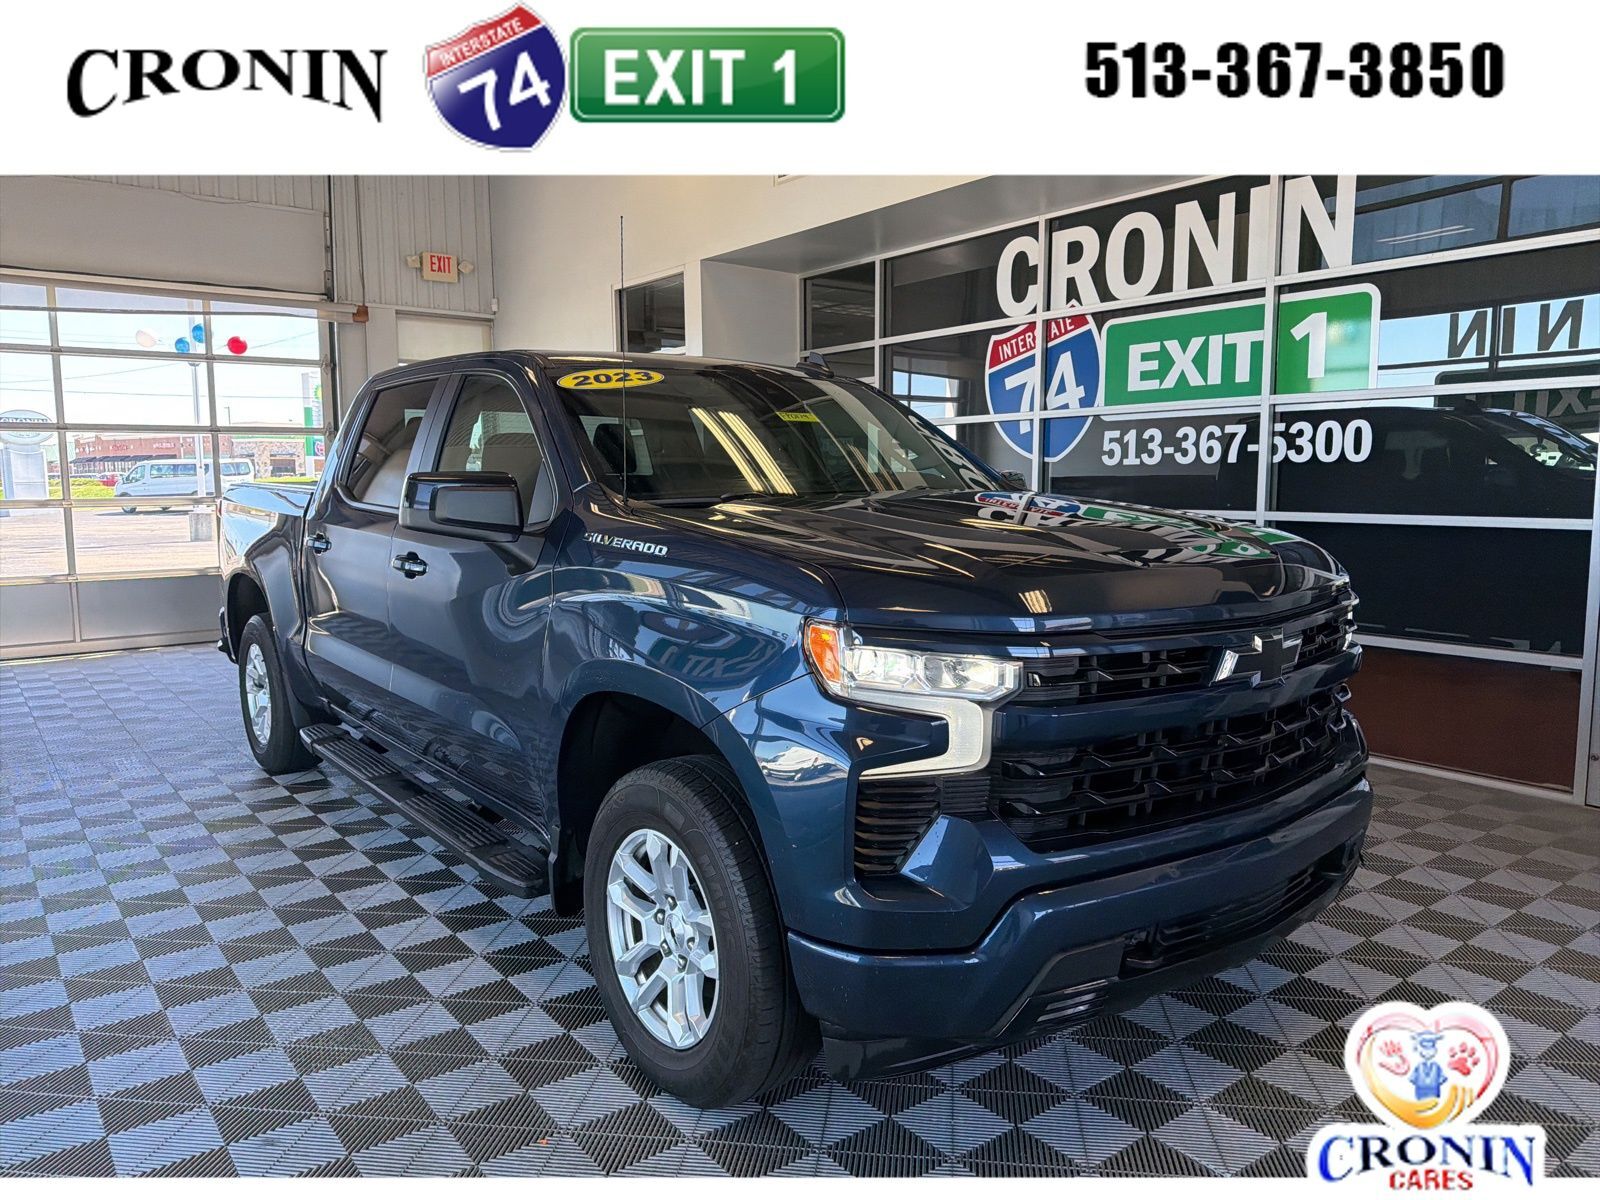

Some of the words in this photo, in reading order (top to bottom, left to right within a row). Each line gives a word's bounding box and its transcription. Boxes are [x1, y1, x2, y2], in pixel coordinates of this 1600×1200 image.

[430, 254, 452, 274] EXIT
[996, 175, 1357, 318] CRONIN
[998, 316, 1075, 362] INTERATE
[1127, 329, 1264, 392] EXIT
[1289, 311, 1328, 379] 1
[572, 371, 654, 387] 2023
[1004, 351, 1086, 435] 74
[583, 532, 668, 556] SILVERADO
